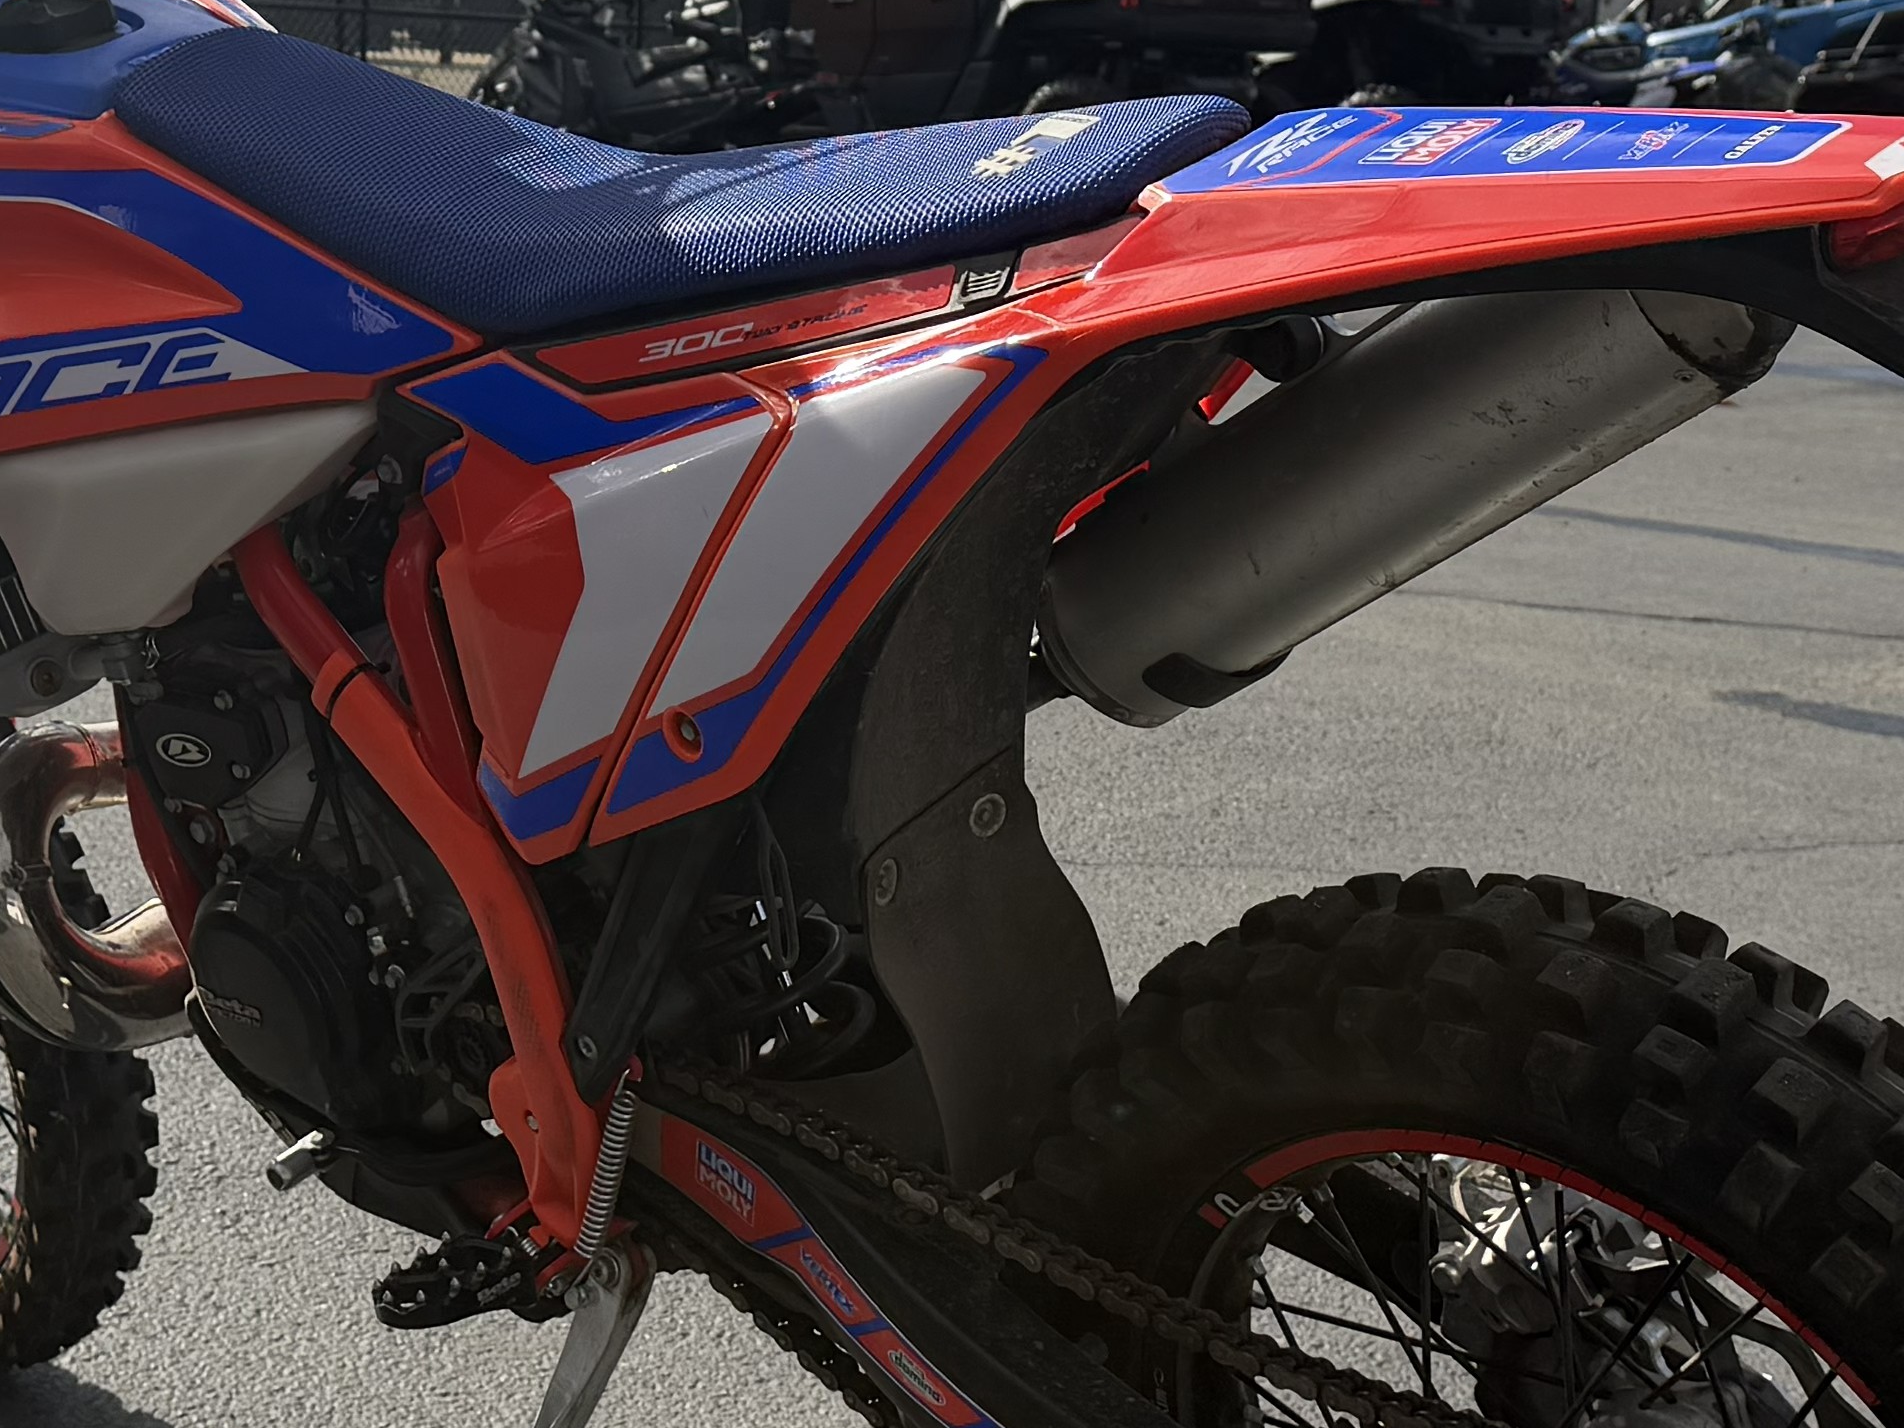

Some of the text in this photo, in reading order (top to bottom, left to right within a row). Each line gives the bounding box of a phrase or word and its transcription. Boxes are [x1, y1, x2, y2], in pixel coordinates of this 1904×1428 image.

[1247, 115, 1358, 173] RACE
[1366, 120, 1450, 162] LIQUI
[1400, 119, 1499, 163] MOLY
[639, 322, 754, 363] 300
[699, 1163, 752, 1220] MOLY
[700, 1143, 753, 1201] LIQUI
